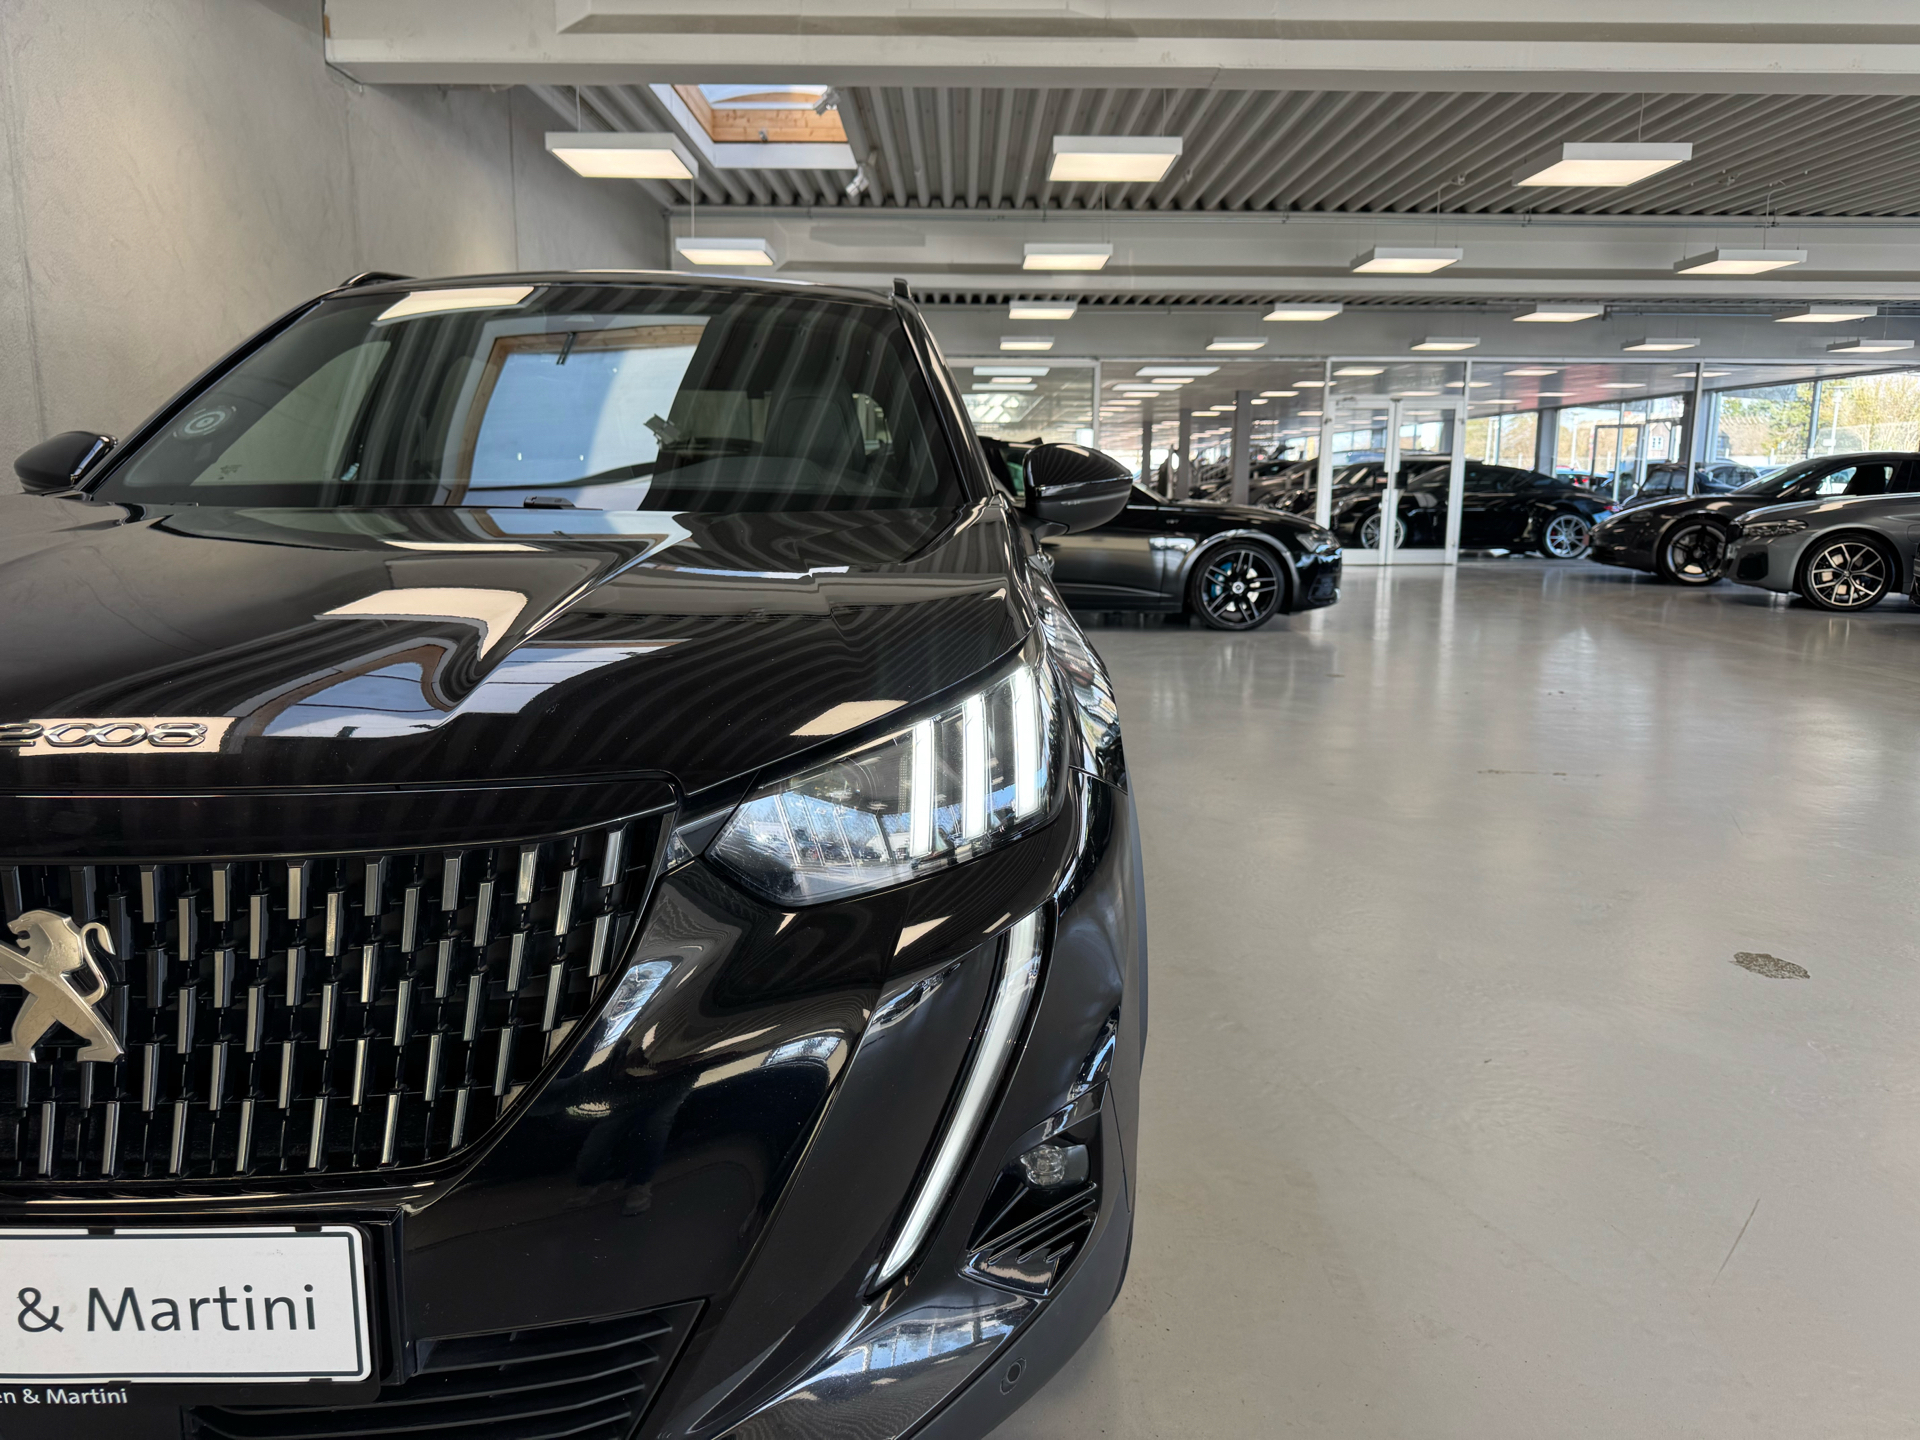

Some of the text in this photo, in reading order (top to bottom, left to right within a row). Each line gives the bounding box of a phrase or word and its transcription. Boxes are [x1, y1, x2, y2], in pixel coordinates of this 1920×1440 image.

[0, 722, 208, 747] 2008
[17, 1284, 316, 1333] & Martini
[0, 1388, 128, 1404] n & Martini
